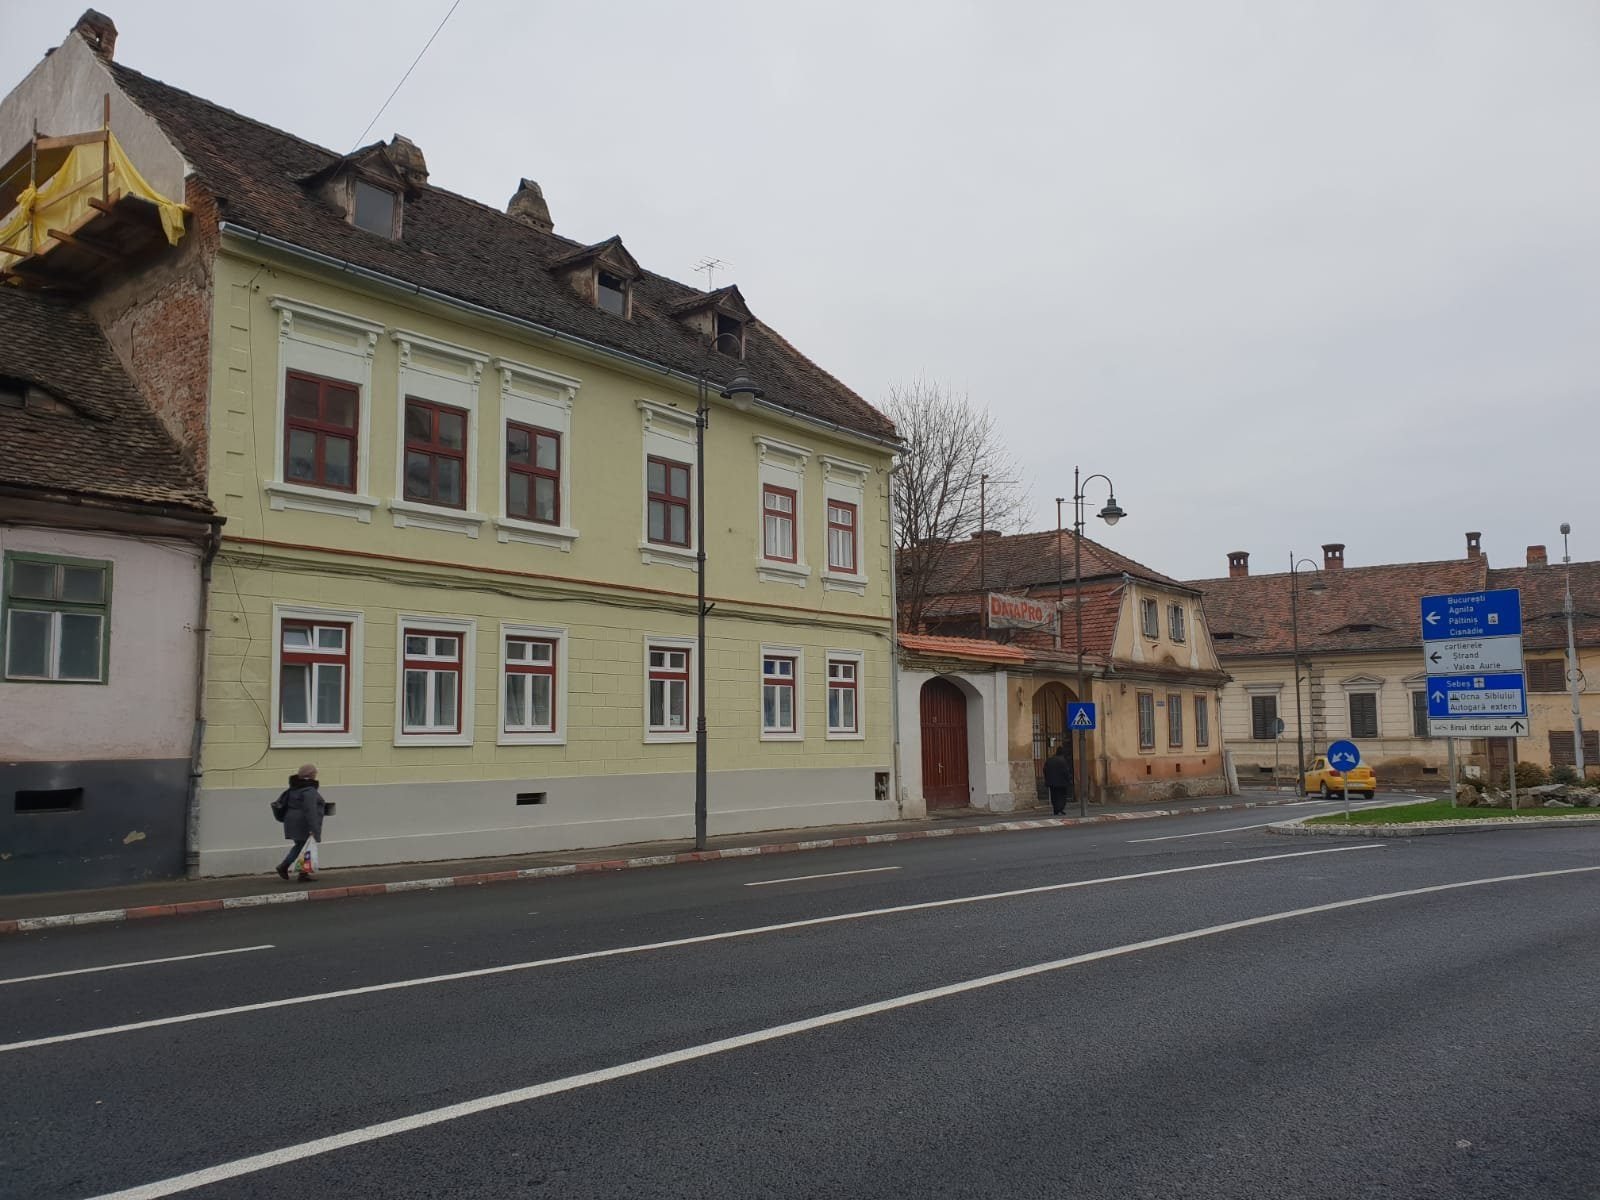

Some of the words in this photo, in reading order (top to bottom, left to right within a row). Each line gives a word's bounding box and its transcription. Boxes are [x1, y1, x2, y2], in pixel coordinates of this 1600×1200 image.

[1449, 606, 1474, 615] Agnita
[1444, 642, 1482, 650] cartierele
[1485, 692, 1515, 700] Sibiului
